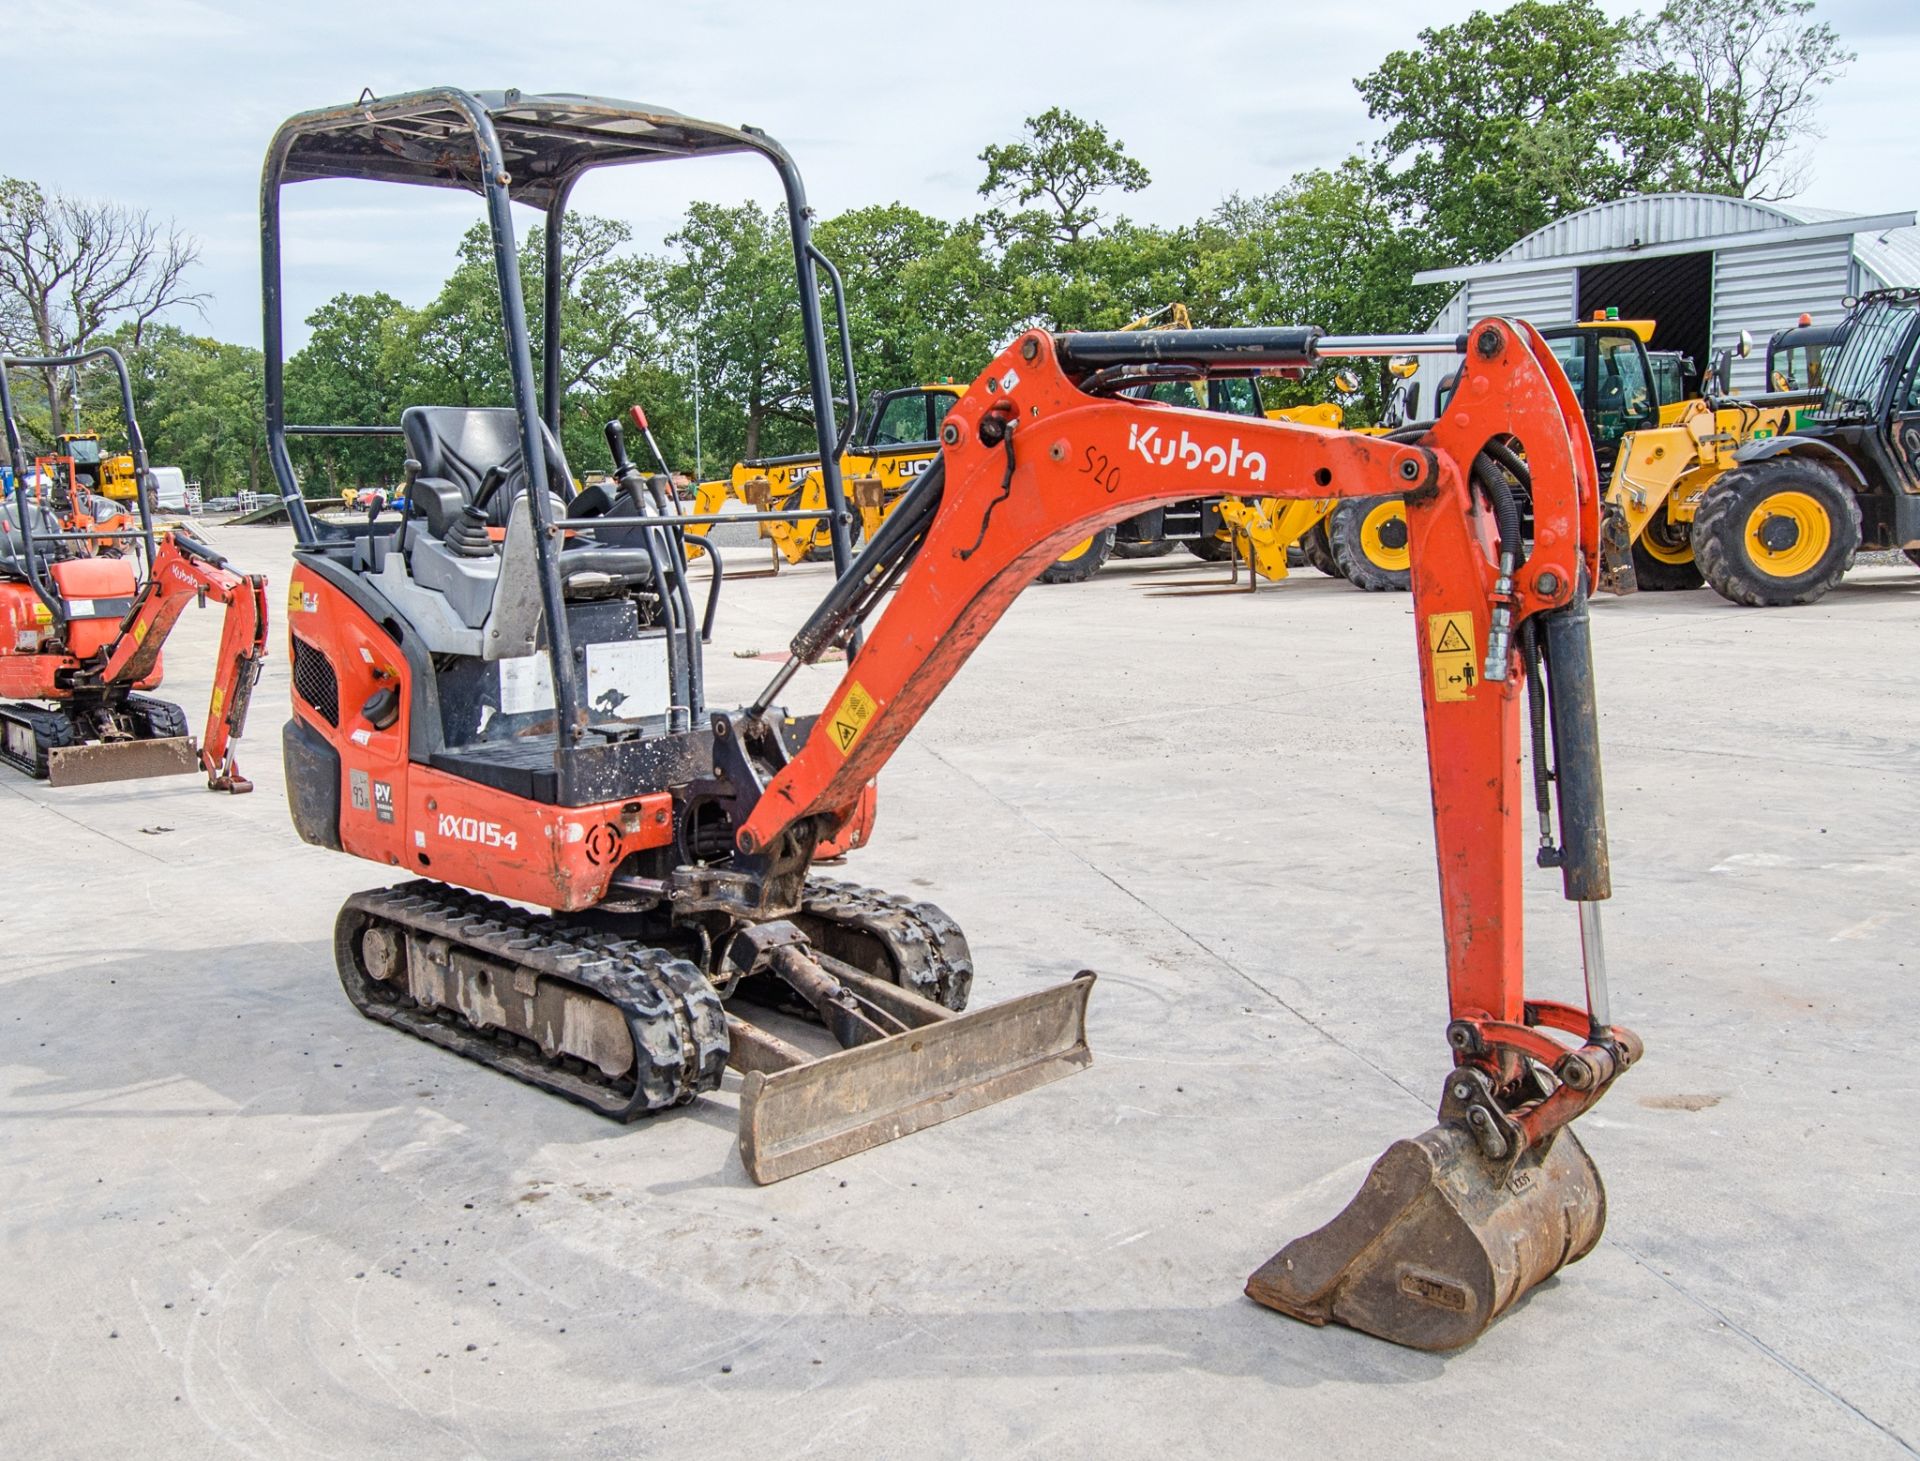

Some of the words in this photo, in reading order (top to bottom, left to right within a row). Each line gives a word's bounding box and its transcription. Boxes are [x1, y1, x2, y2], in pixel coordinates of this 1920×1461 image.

[900, 459, 934, 476] JC
[1079, 446, 1120, 493] S20
[1128, 423, 1267, 481] Kubota
[172, 564, 198, 588] Kubota
